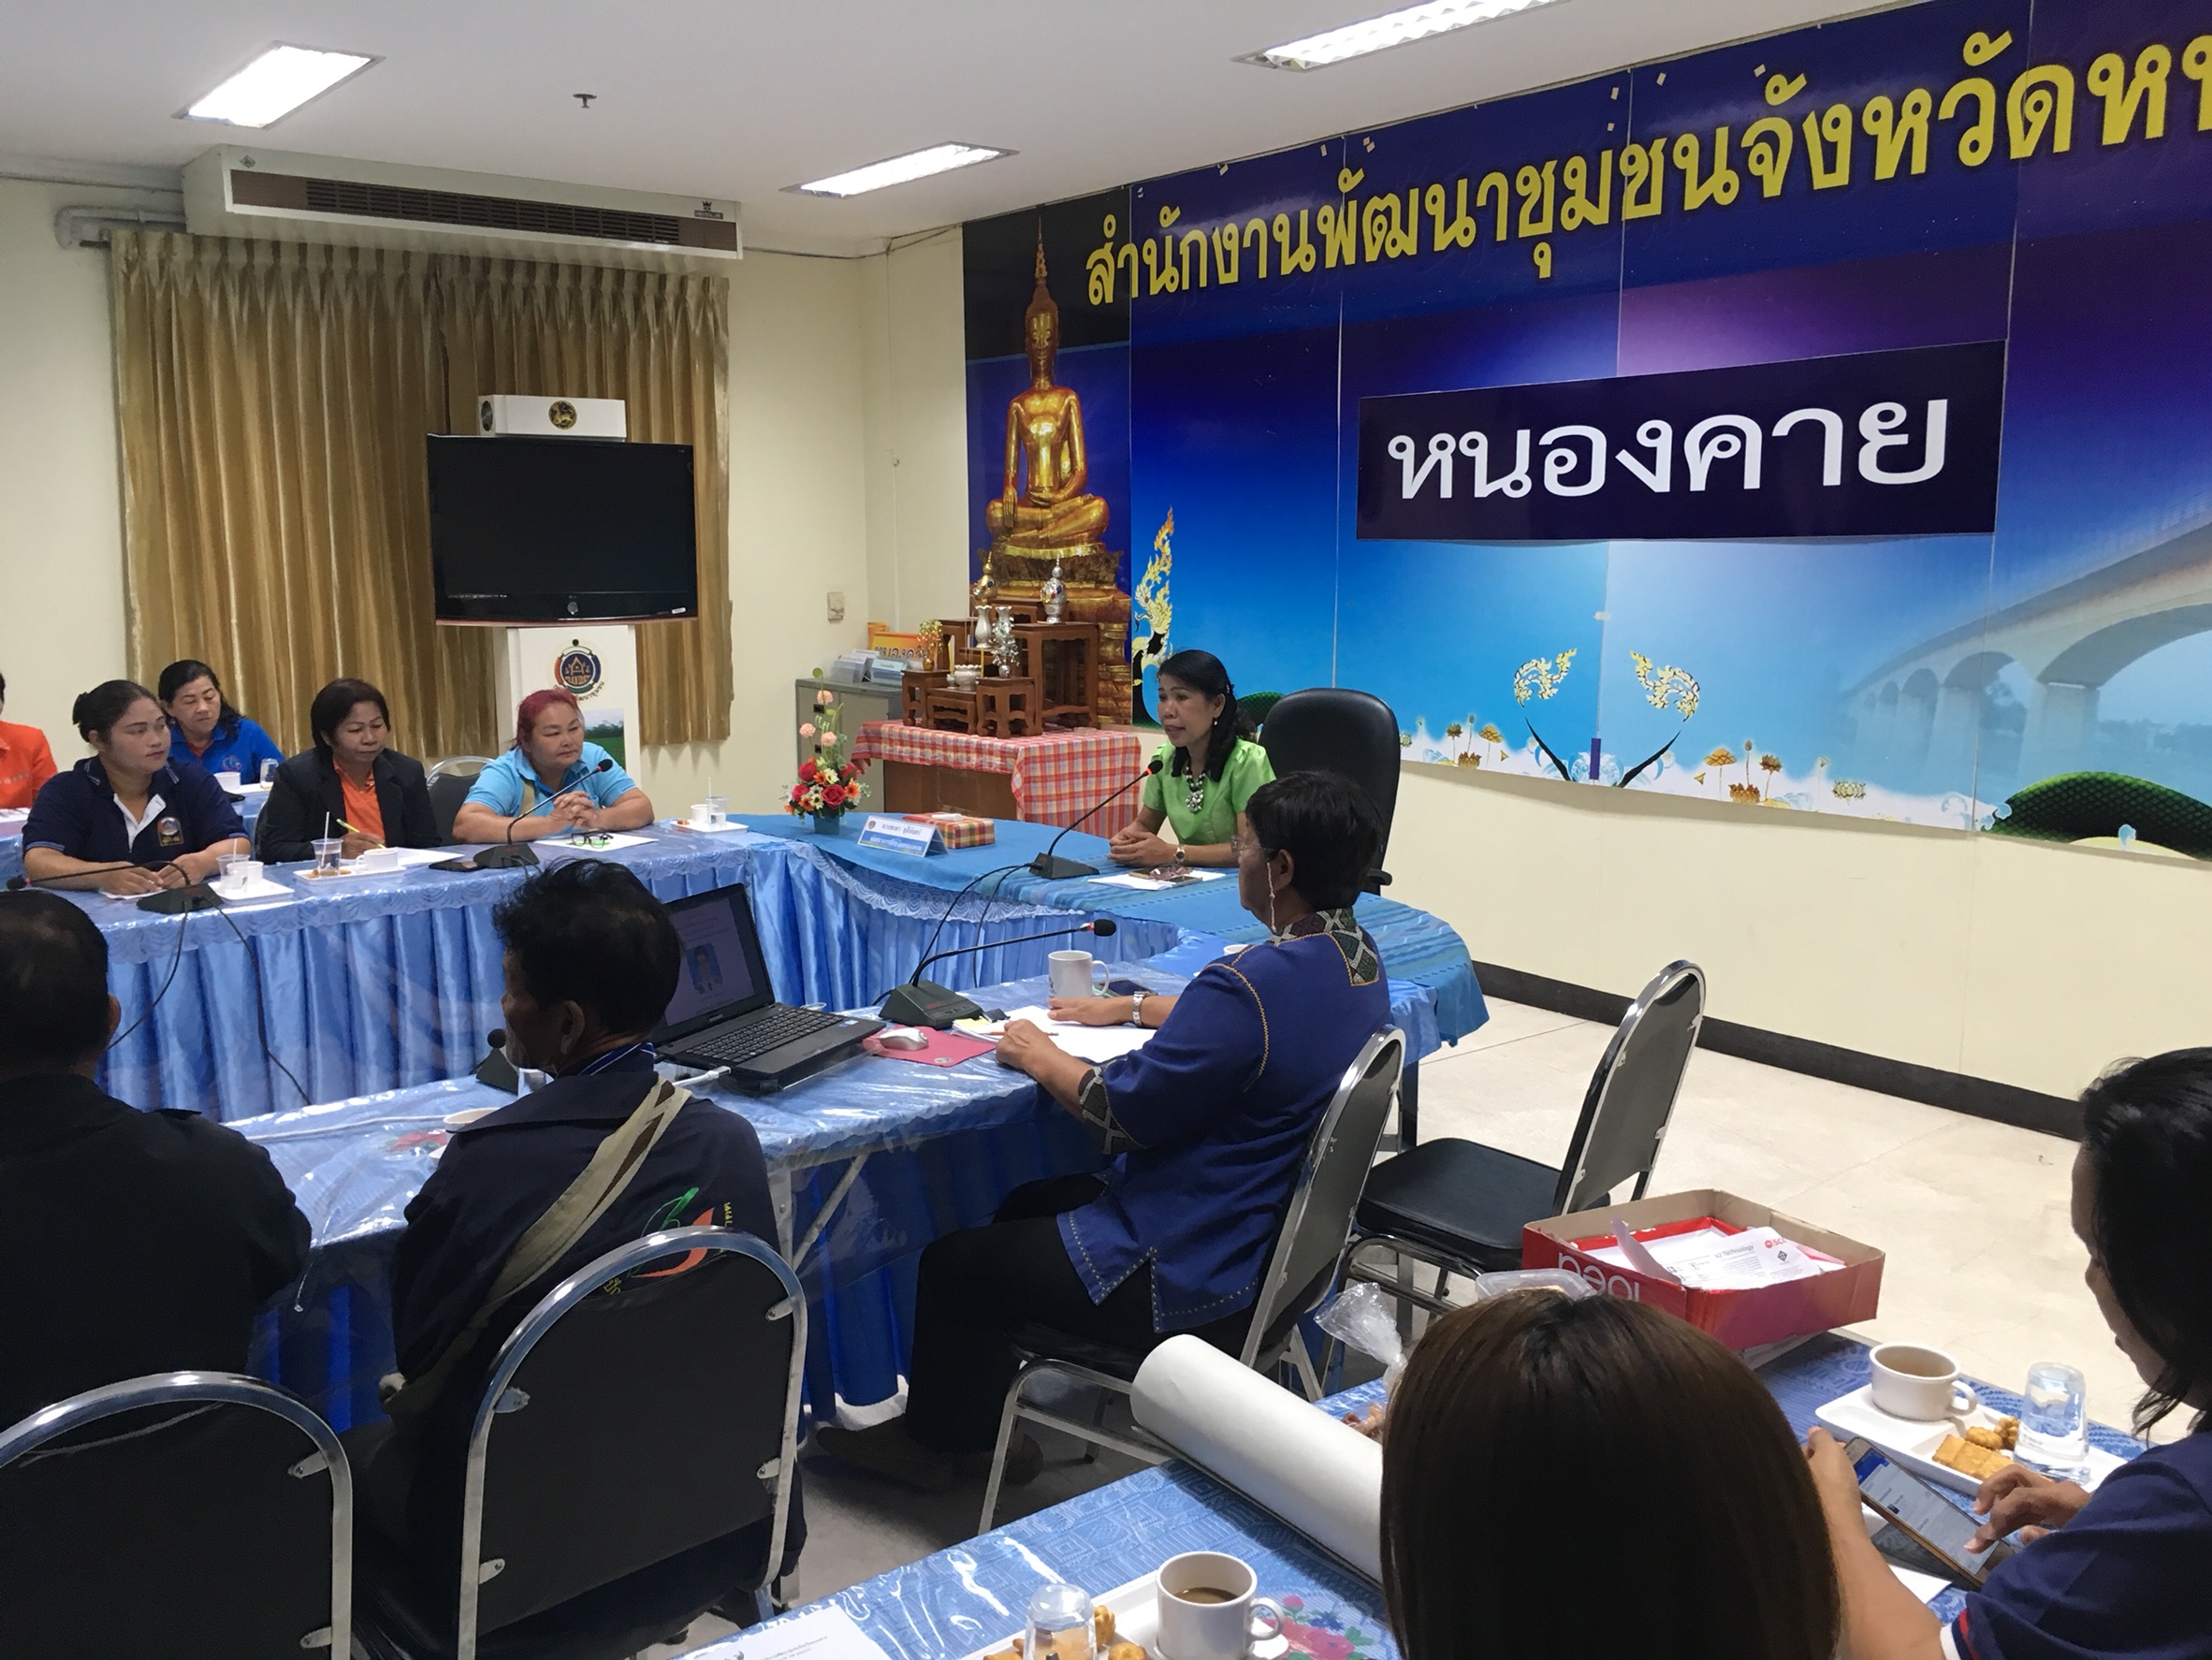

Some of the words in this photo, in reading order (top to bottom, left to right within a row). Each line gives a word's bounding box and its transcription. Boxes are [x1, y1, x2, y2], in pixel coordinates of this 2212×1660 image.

[1386, 399, 1947, 499] หนองคาย
[1724, 1244, 1754, 1259] Technology
